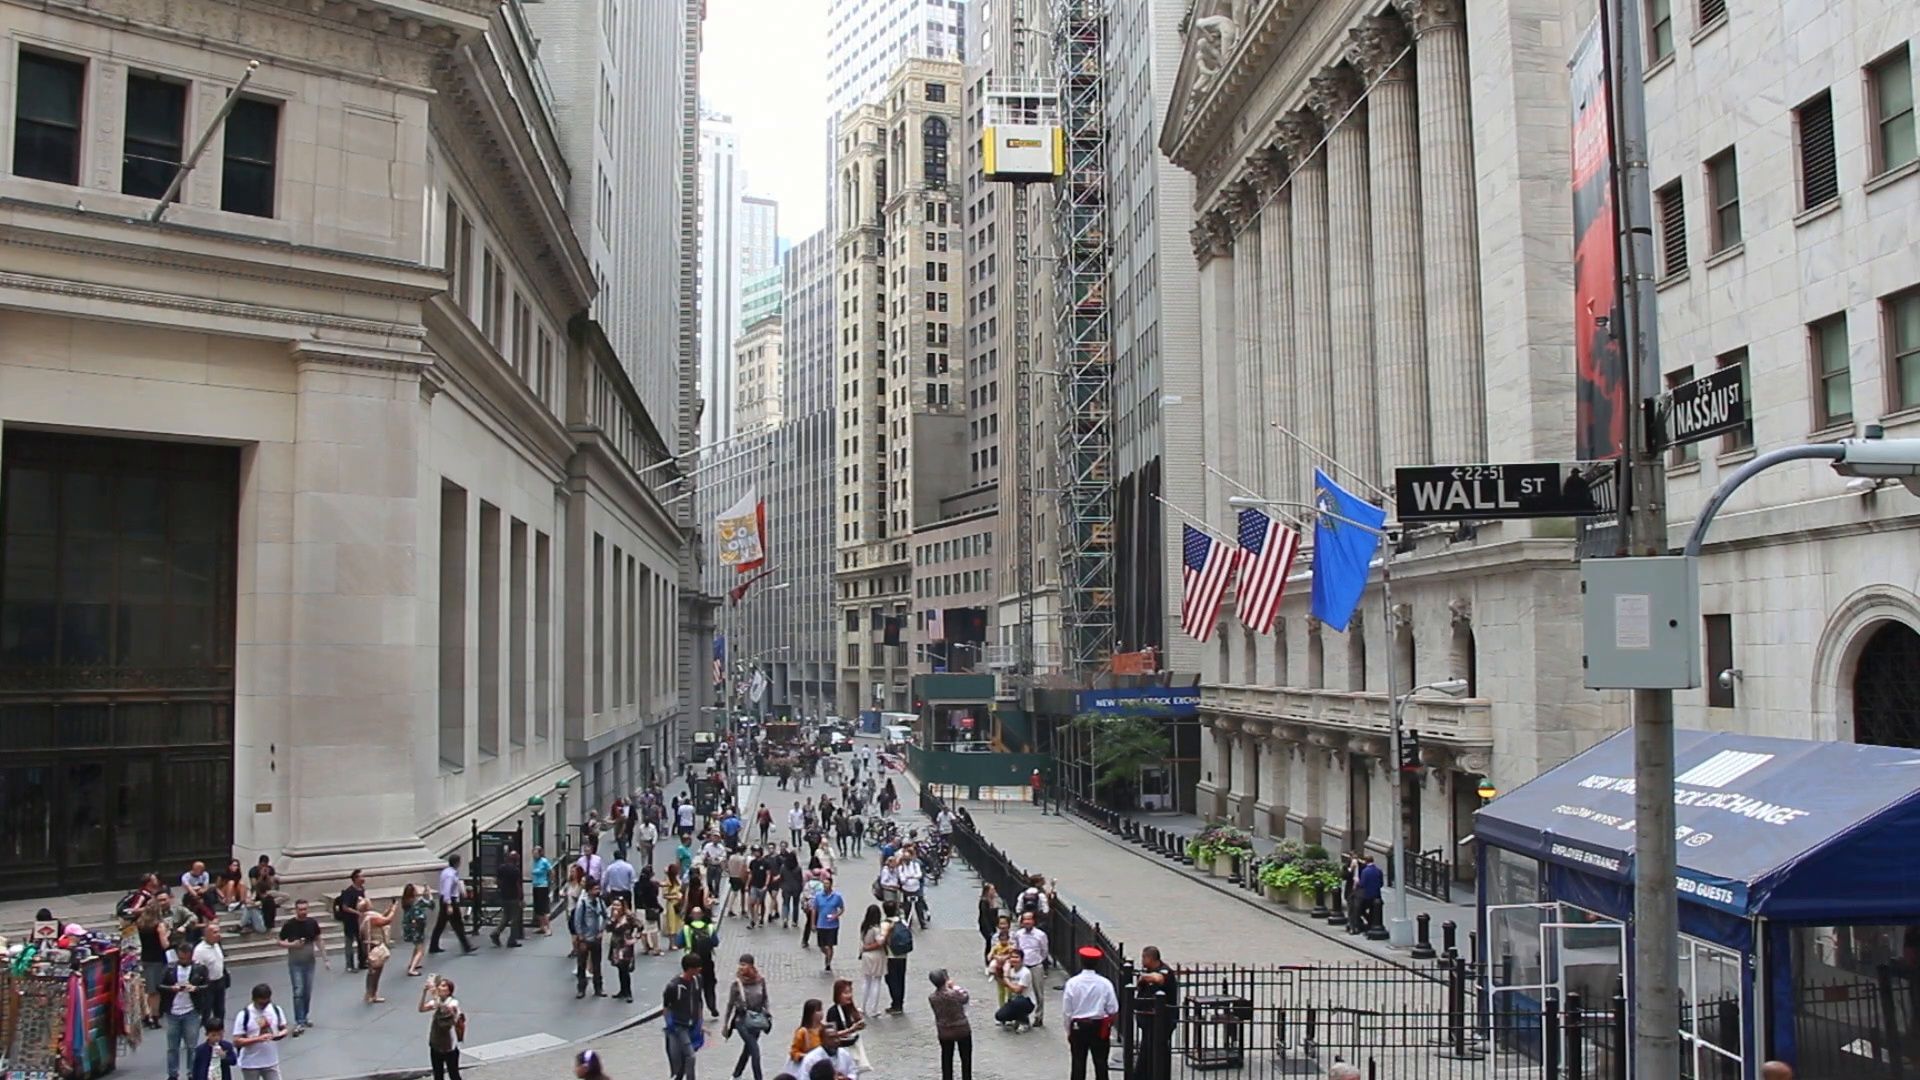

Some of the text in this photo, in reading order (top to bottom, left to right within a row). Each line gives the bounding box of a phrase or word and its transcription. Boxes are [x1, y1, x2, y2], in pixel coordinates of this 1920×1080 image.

[1676, 382, 1740, 435] NASSAU ST
[1464, 466, 1504, 480] 22-51
[1412, 478, 1545, 511] WALL ST
[1095, 699, 1116, 707] NEW
[1577, 774, 1618, 790] NEW
[1607, 778, 1637, 796] YOR
[1694, 792, 1804, 825] EXCHANGE
[1551, 843, 1620, 871] EMPLOYEE ENTRANCE
[1696, 882, 1733, 904] GUESTS
